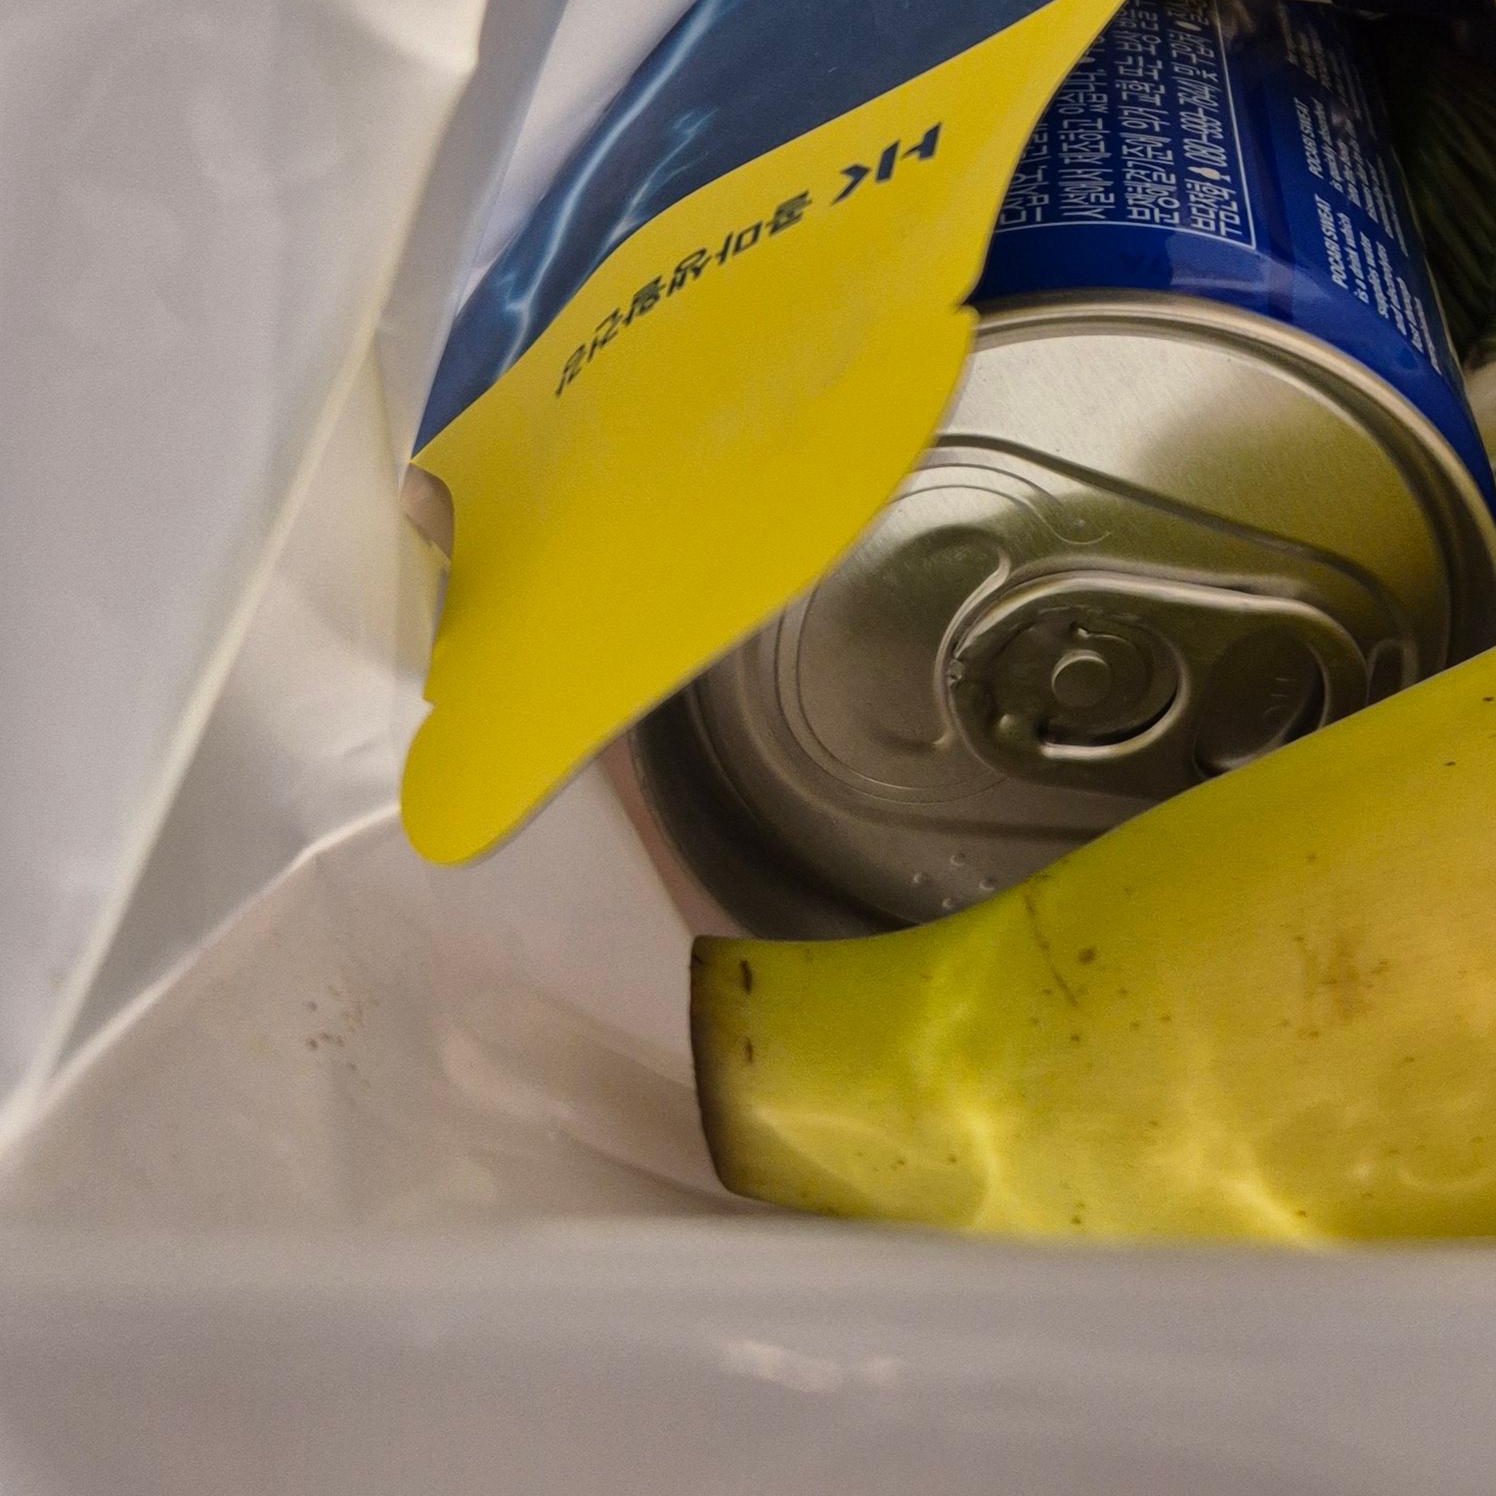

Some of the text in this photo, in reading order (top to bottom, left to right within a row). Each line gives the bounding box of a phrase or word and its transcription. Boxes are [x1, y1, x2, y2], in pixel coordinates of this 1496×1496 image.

[1114, 55, 1163, 81] 또는
[1115, 30, 1161, 56] 보상
[1168, 28, 1216, 67] 구입처
[1114, 79, 1165, 106] 교환
[1117, 104, 1170, 132] 의거
[832, 121, 942, 206] HK
[1057, 68, 1116, 220] 시설에서 제조하고 있습니다.
[1294, 96, 1325, 180] POCARI SWEAT
[1119, 132, 1181, 224] 분쟁해결기준에
[1184, 179, 1243, 237] 부담전화
[1314, 193, 1349, 290] POCARI SWEAT
